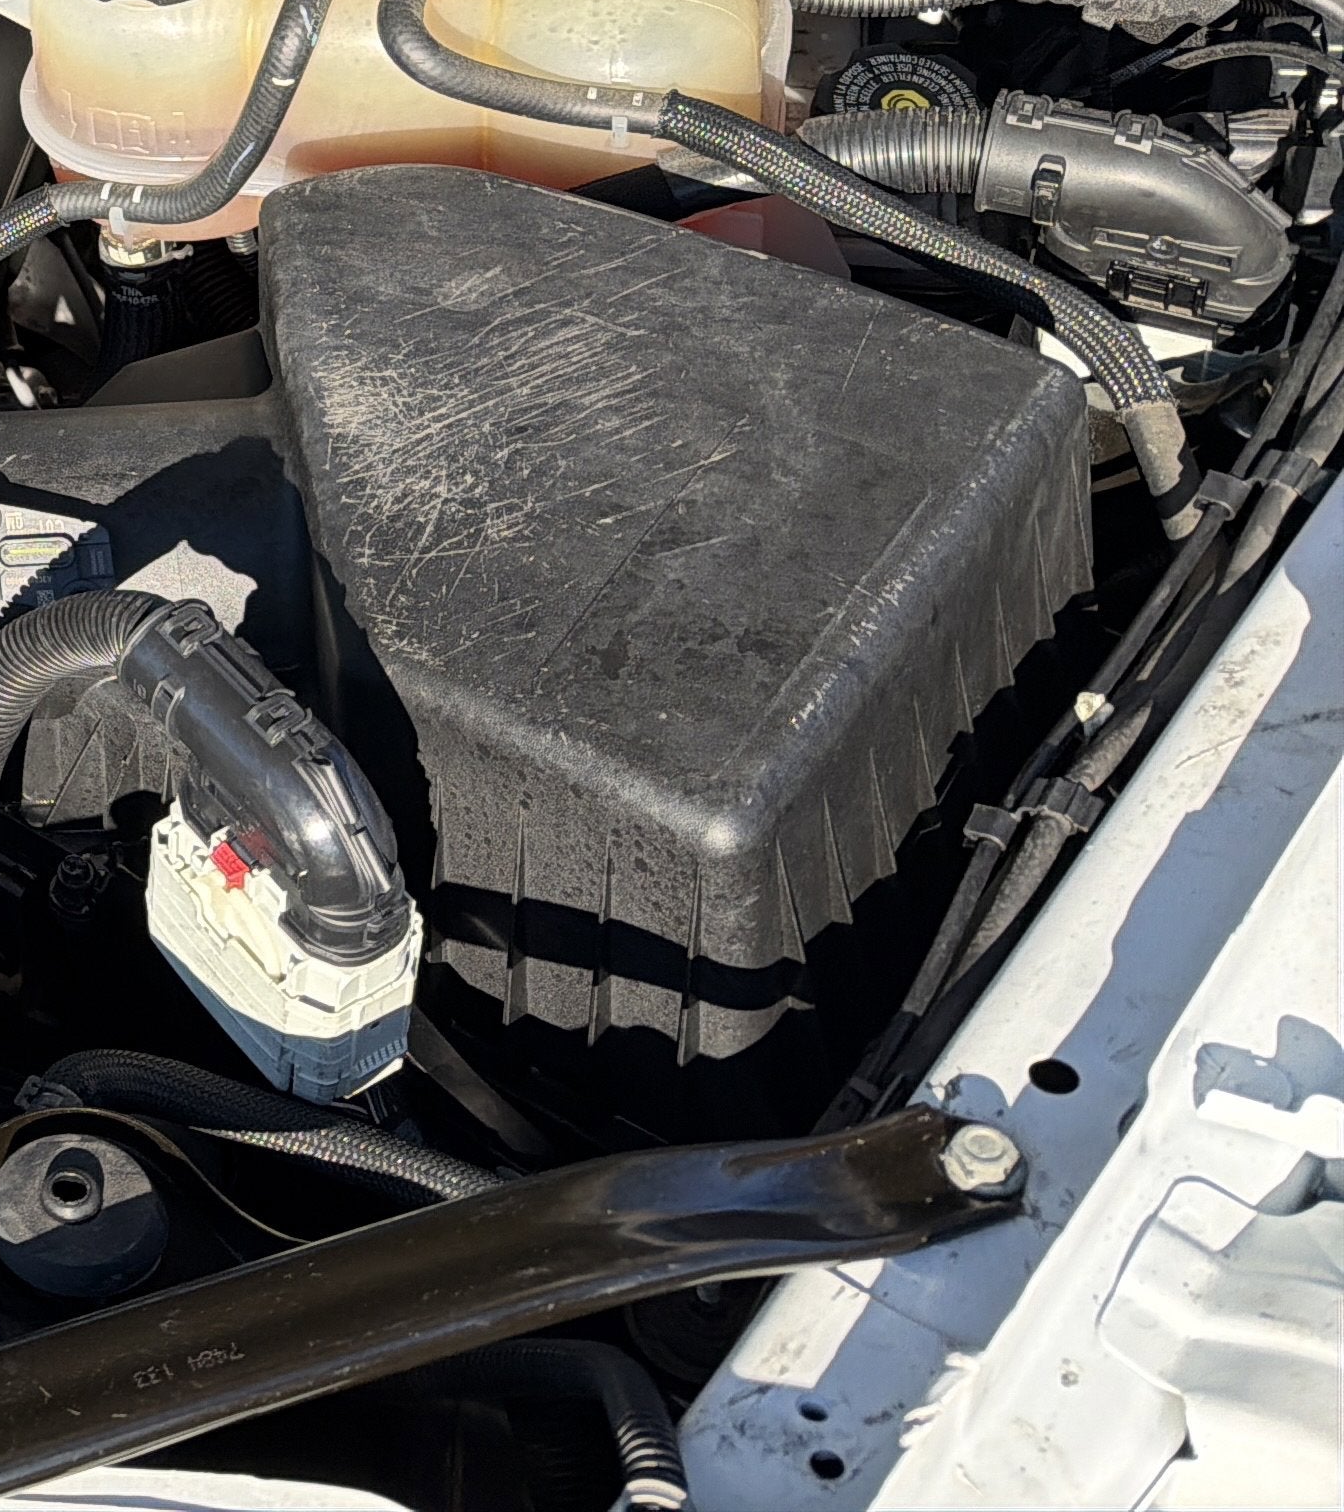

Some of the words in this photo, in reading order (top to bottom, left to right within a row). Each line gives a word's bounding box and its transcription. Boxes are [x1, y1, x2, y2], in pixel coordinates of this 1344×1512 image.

[866, 54, 918, 66] CONTAINER.
[873, 64, 894, 75] ONLY
[896, 62, 913, 71] USE
[919, 57, 951, 77] SEALED
[880, 72, 911, 83] FILLER
[912, 73, 940, 92] CLEAN
